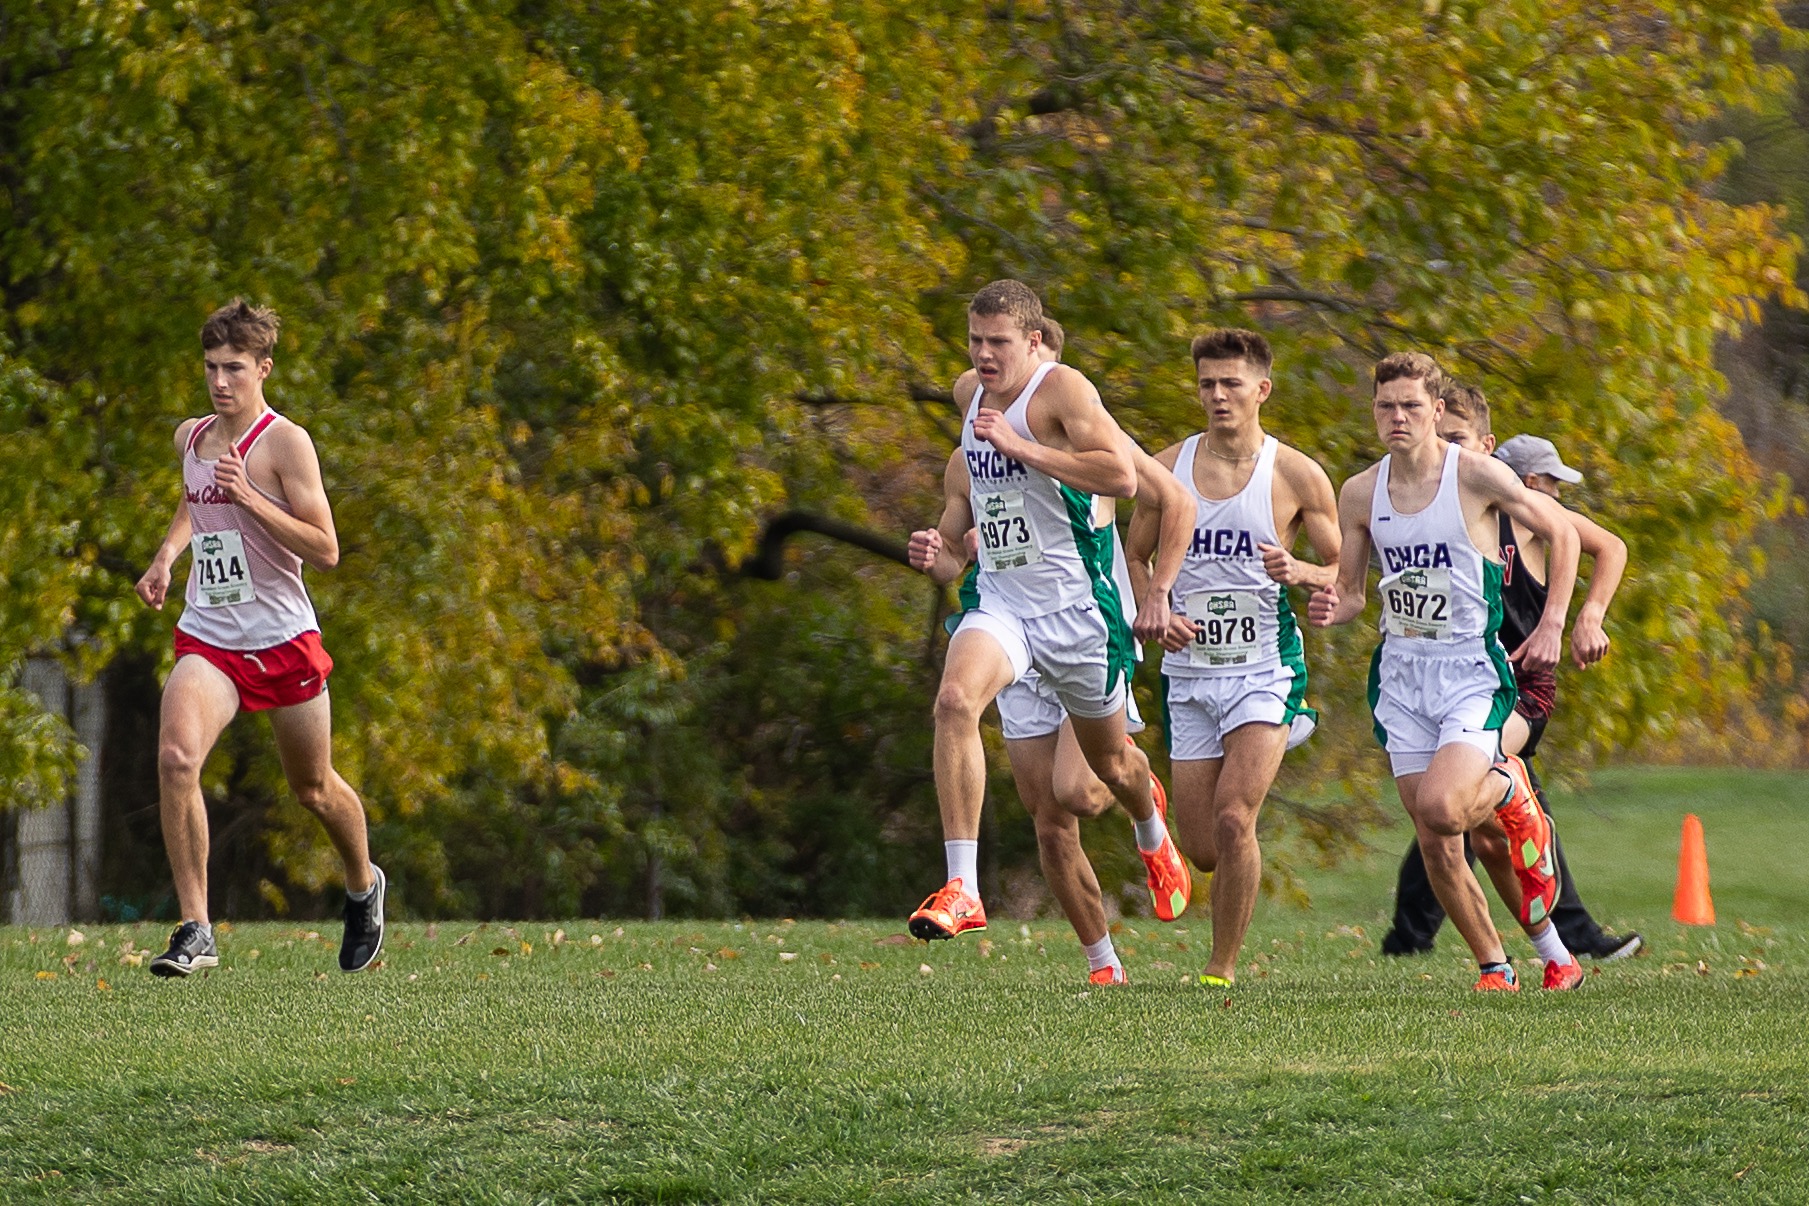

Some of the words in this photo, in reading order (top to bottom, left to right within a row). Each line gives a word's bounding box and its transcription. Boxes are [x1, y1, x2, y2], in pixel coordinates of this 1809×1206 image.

[966, 450, 1028, 479] CHCA
[980, 516, 1030, 549] 6973
[1187, 528, 1254, 558] HCA
[198, 556, 244, 585] 7414
[1383, 542, 1453, 573] CHCA
[1388, 589, 1448, 621] 6972
[1194, 616, 1256, 645] 6978
